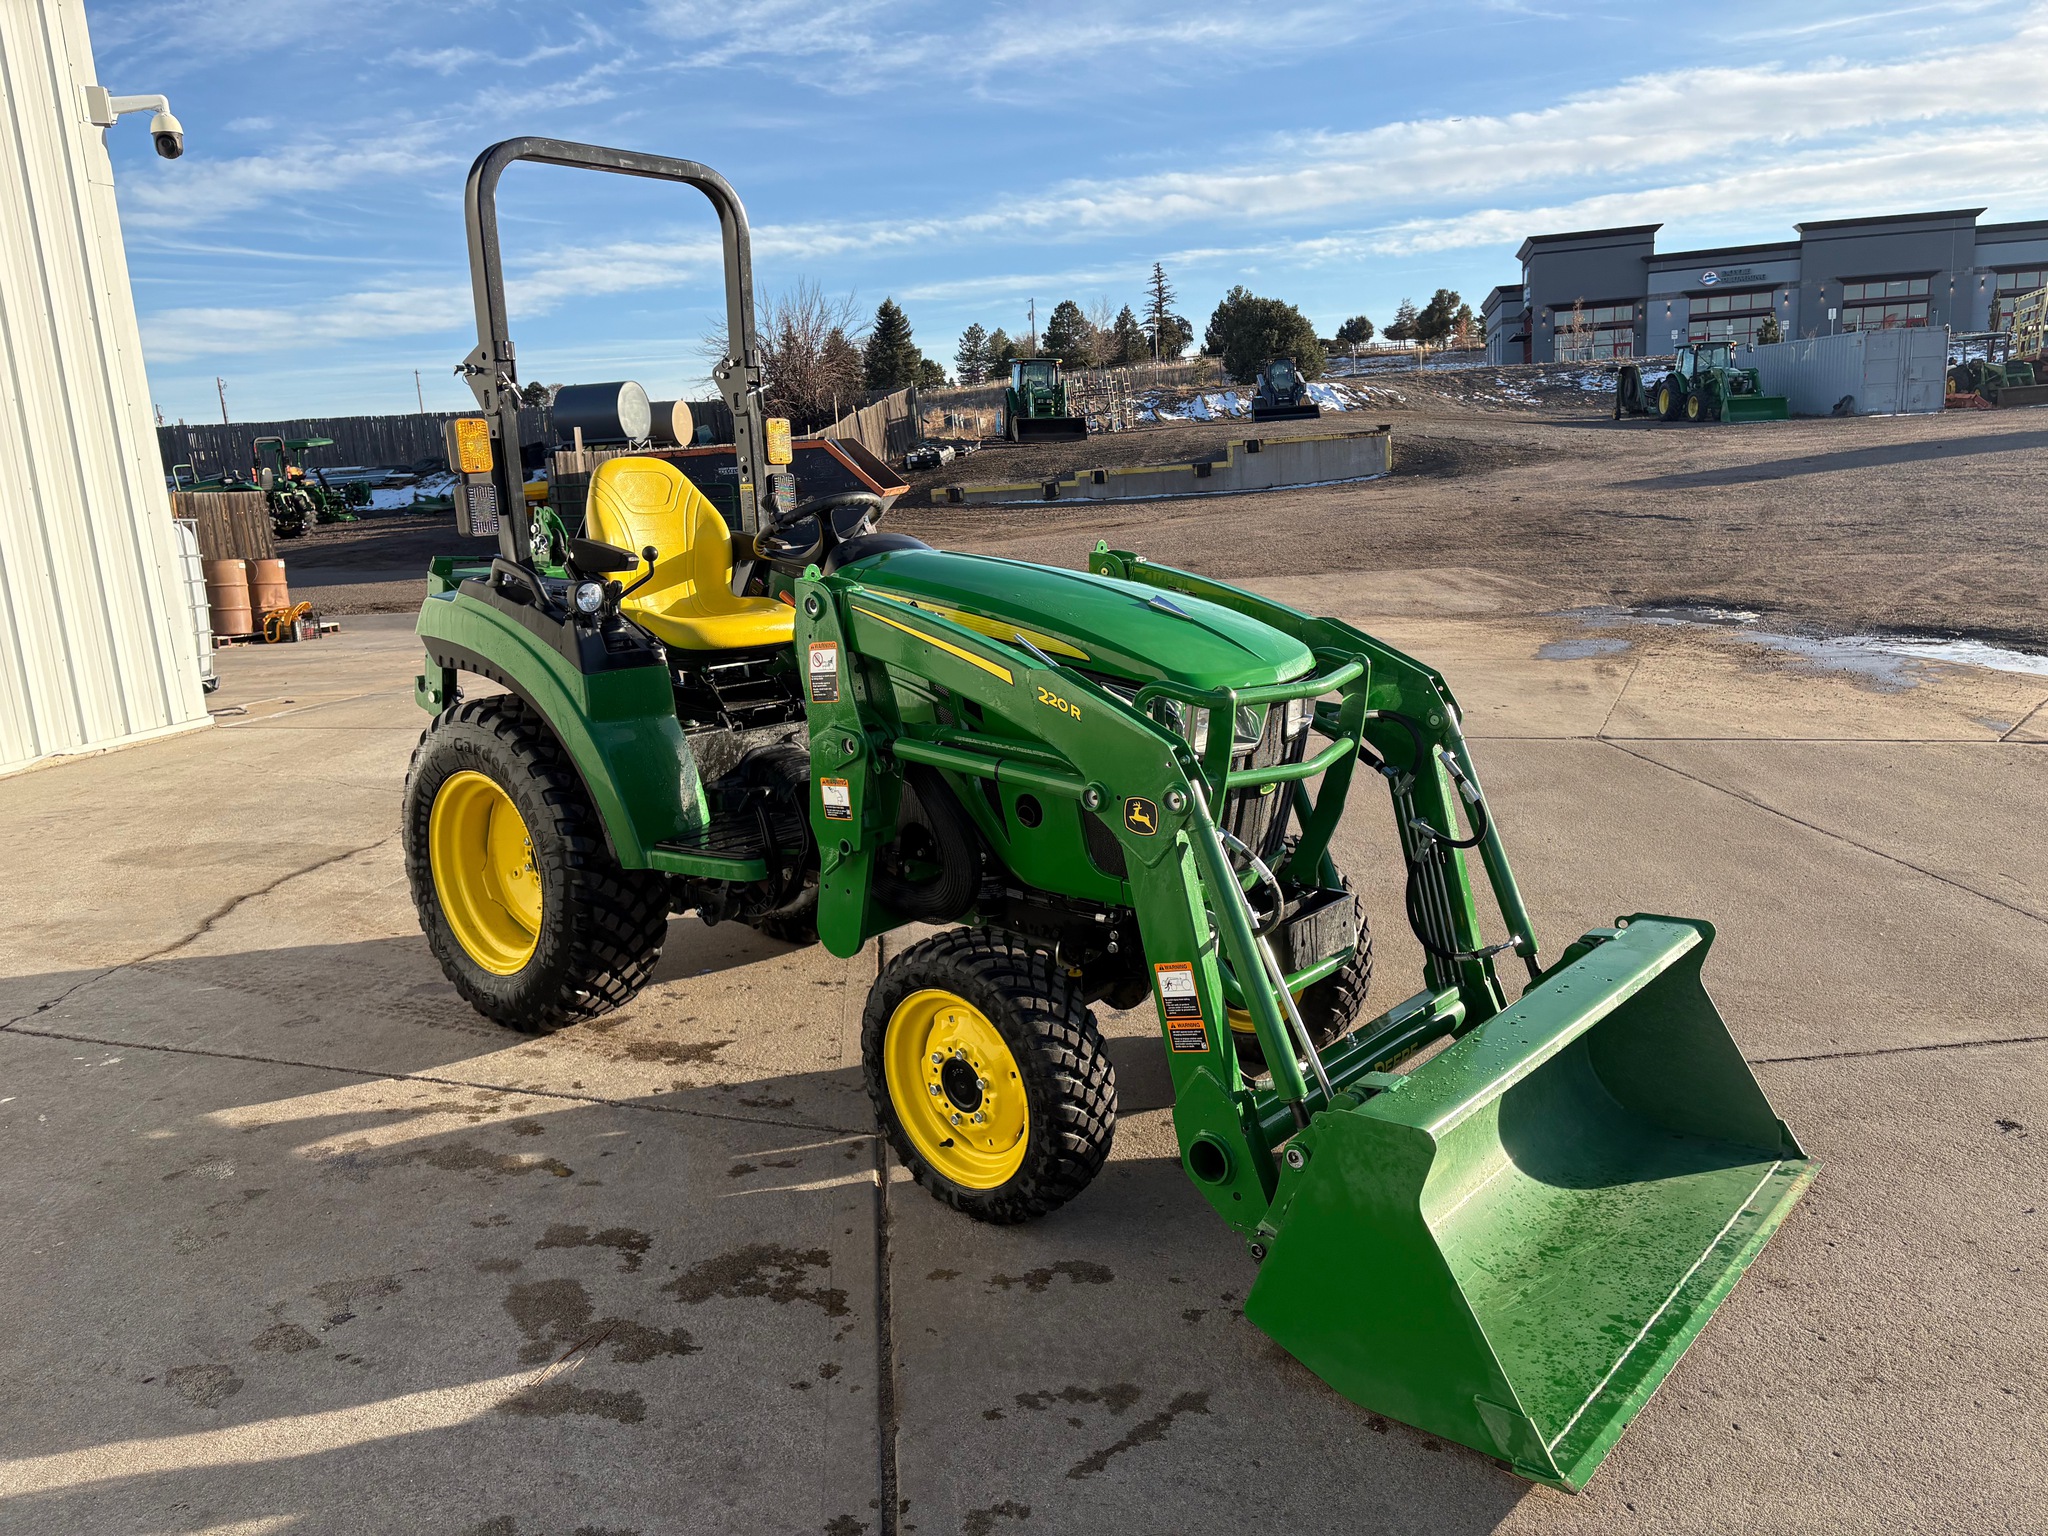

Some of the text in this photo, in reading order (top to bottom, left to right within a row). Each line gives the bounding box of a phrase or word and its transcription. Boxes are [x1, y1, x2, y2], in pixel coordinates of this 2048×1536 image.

[1037, 686, 1081, 721] 220 R
[454, 738, 510, 782] Garden
[1374, 1041, 1419, 1073] DEERE
